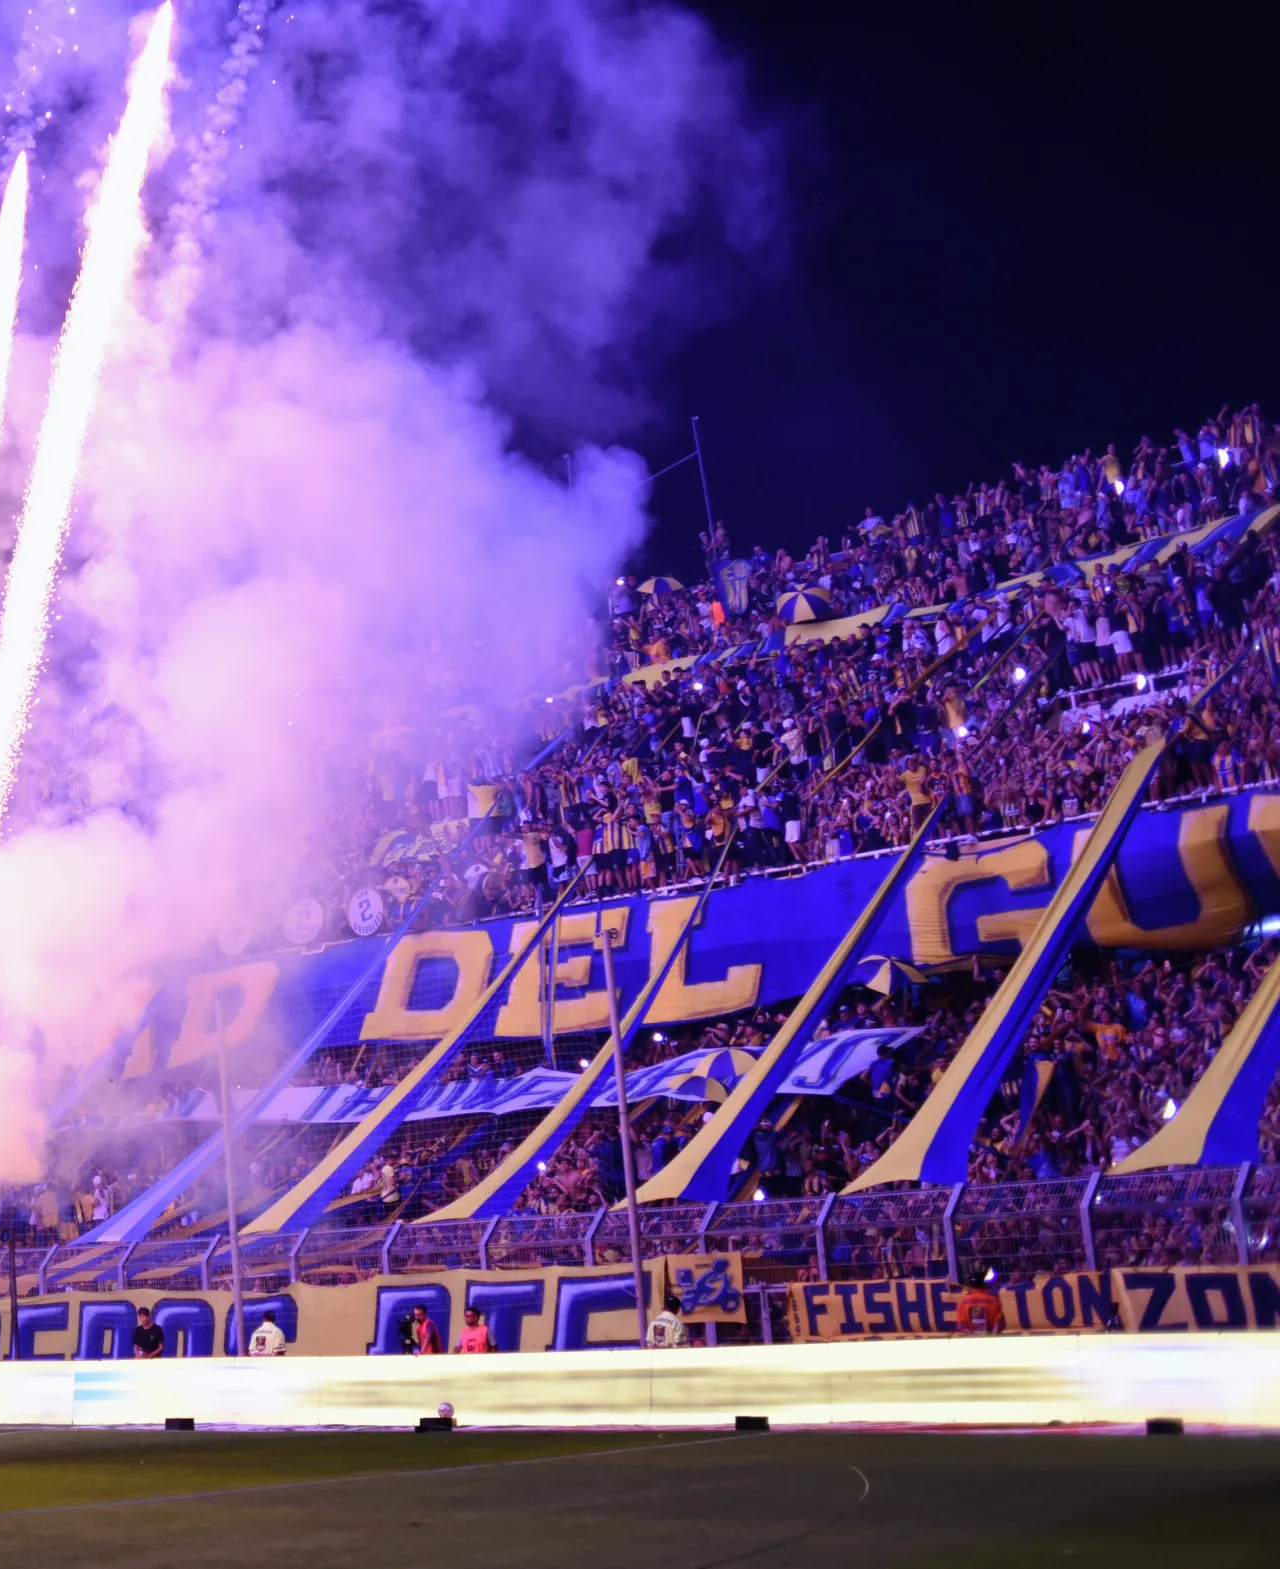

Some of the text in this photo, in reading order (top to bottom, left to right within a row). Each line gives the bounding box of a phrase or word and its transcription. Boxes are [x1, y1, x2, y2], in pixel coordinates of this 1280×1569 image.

[358, 898, 373, 922] 2
[359, 896, 761, 1041] DEL
[803, 1273, 1113, 1336] FISHETON
